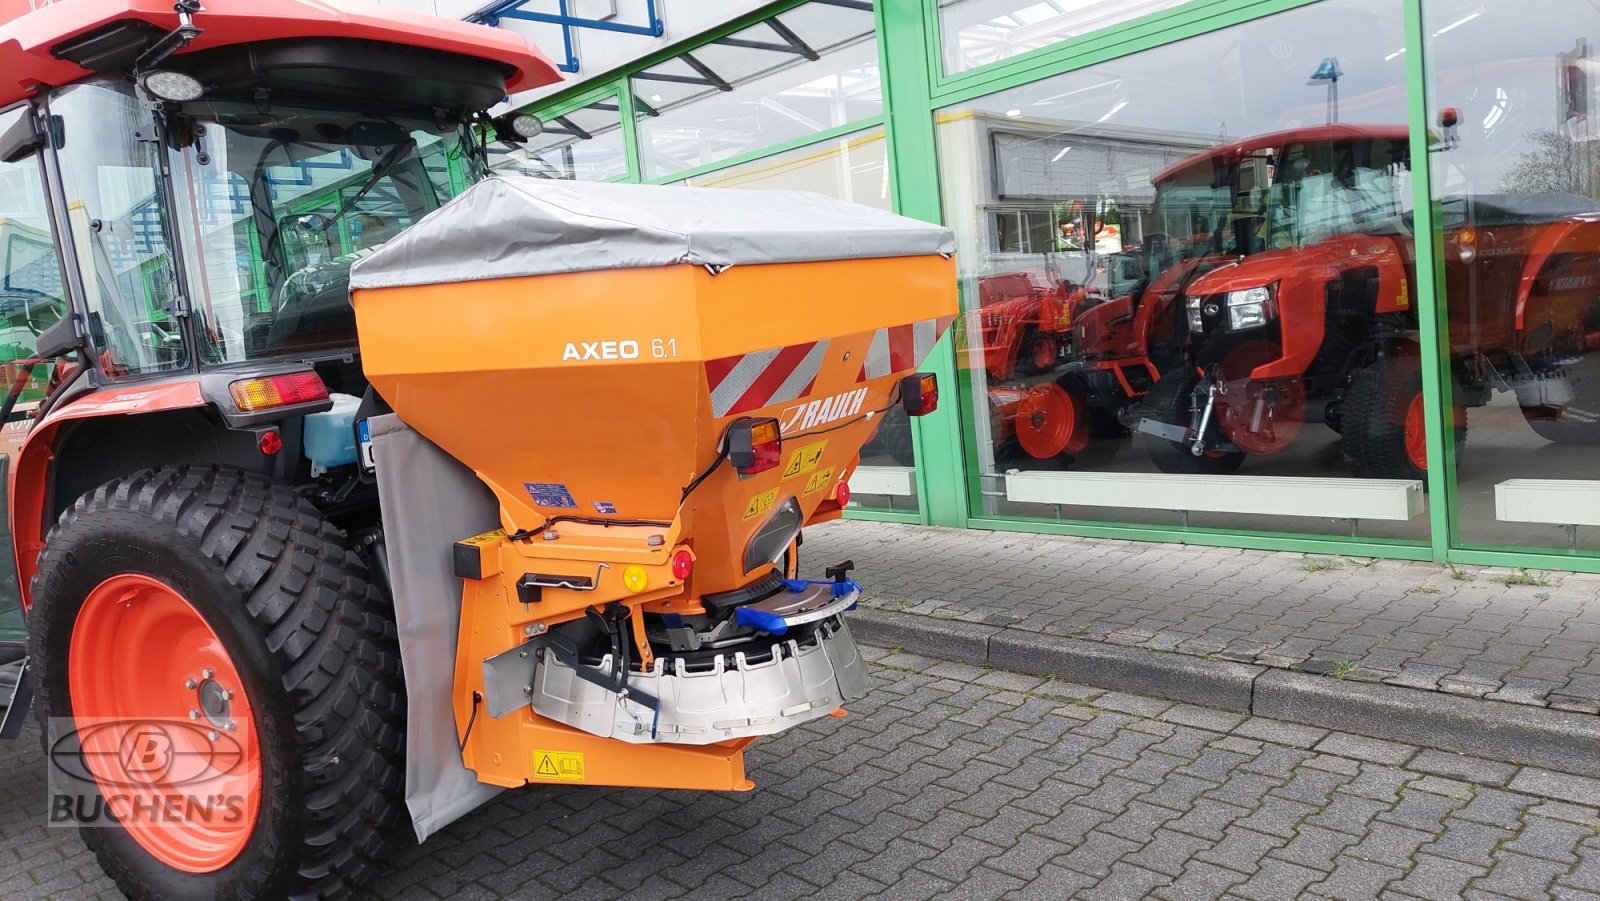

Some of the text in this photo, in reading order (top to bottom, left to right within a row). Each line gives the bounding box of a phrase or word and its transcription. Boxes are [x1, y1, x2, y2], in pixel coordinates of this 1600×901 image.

[562, 338, 678, 361] AXEO 6.1
[800, 387, 868, 430] RAUCH
